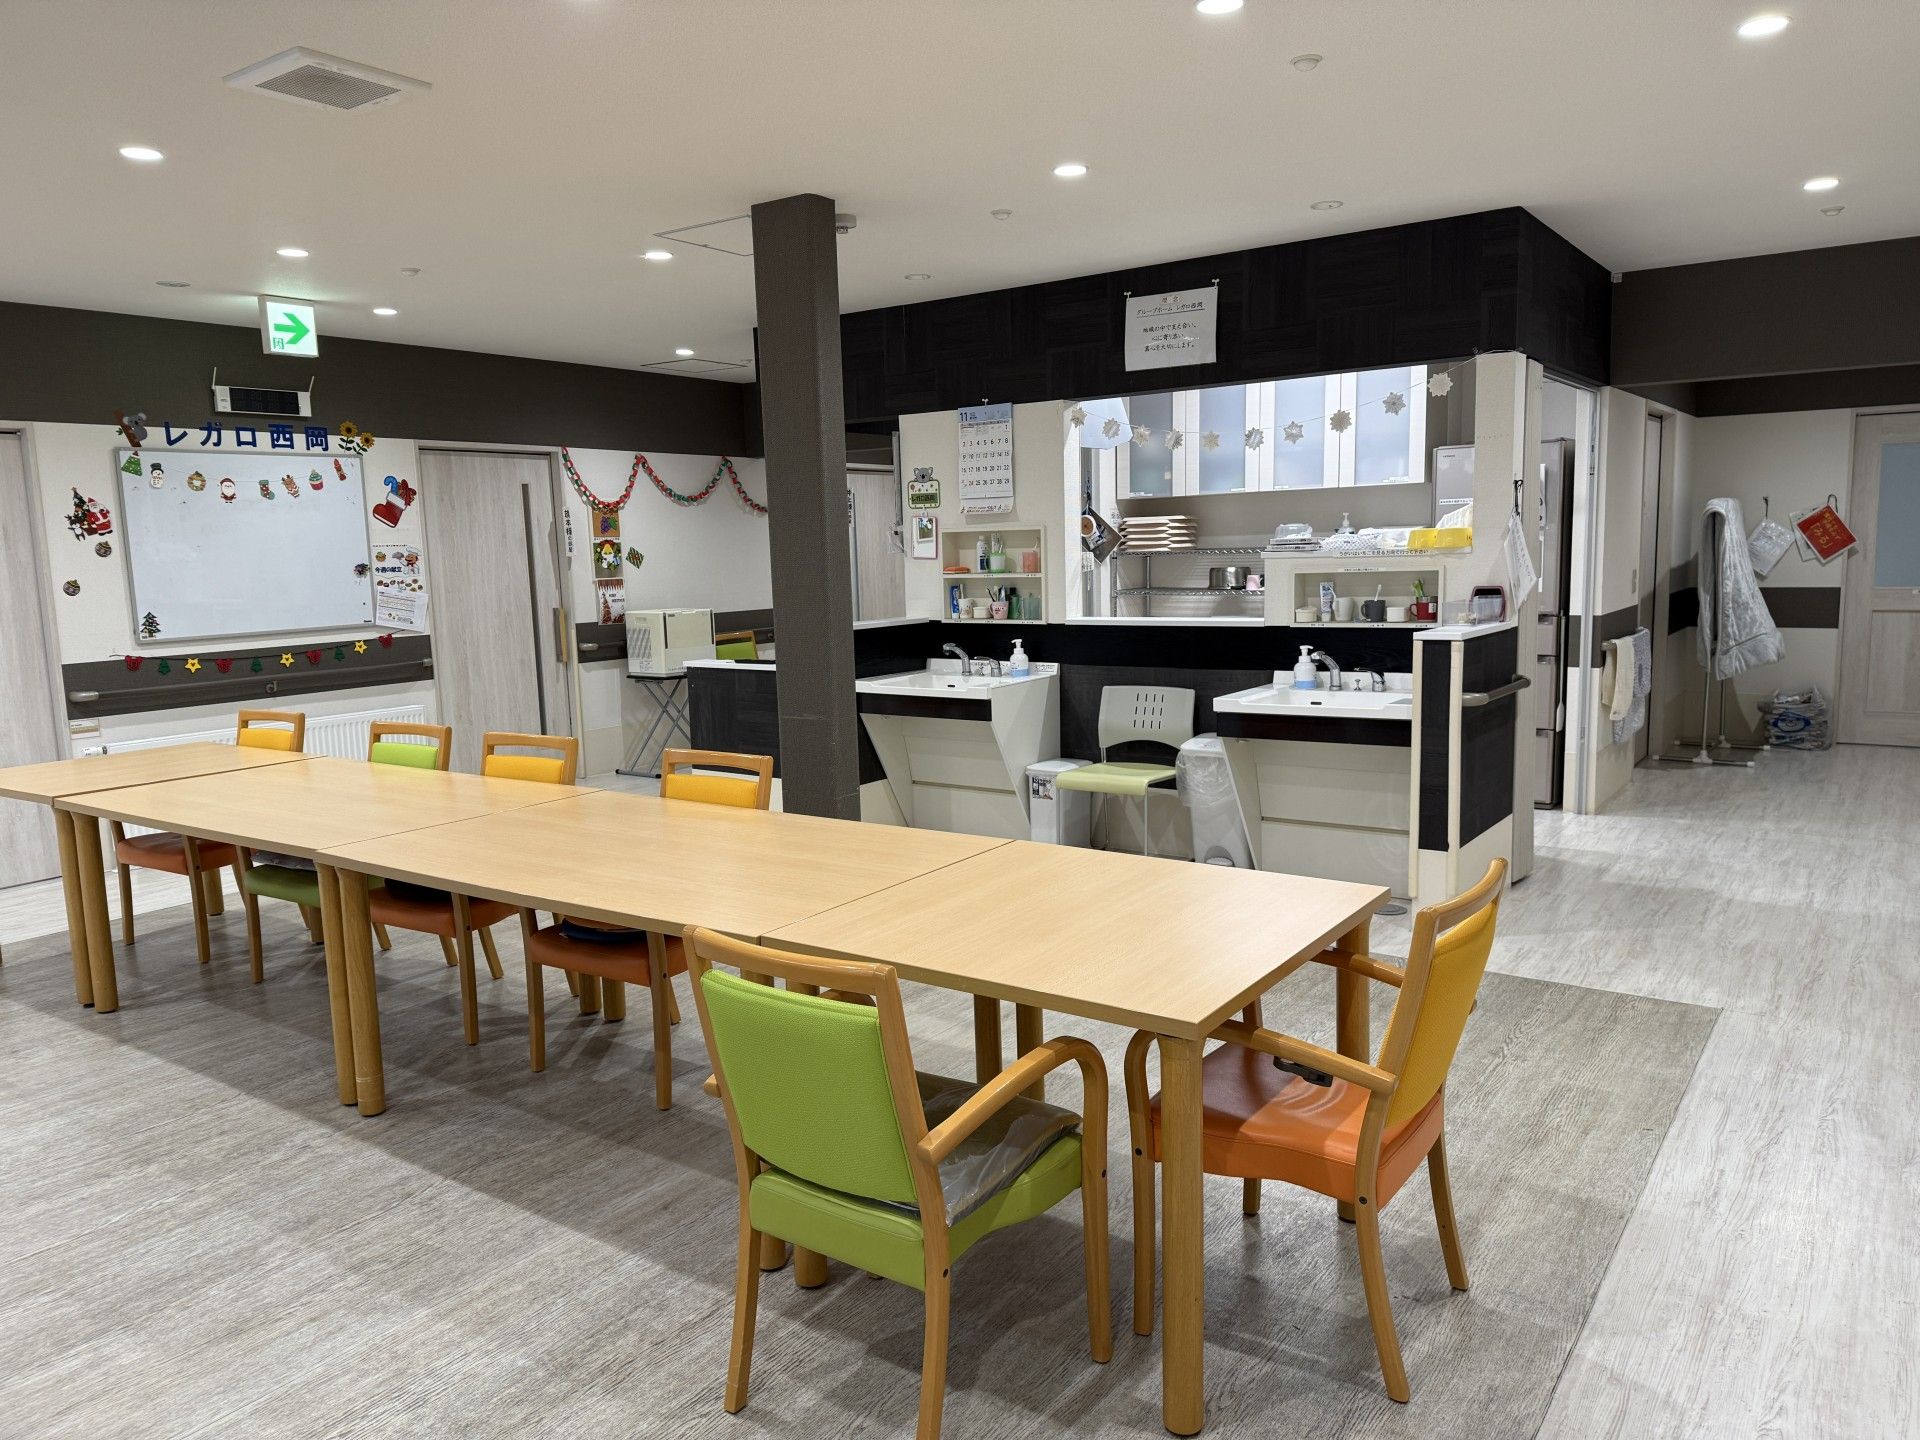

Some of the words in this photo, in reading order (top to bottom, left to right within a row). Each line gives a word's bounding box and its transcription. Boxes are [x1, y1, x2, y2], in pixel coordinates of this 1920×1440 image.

[960, 411, 968, 422] 11
[164, 421, 329, 452] レガロ西岡
